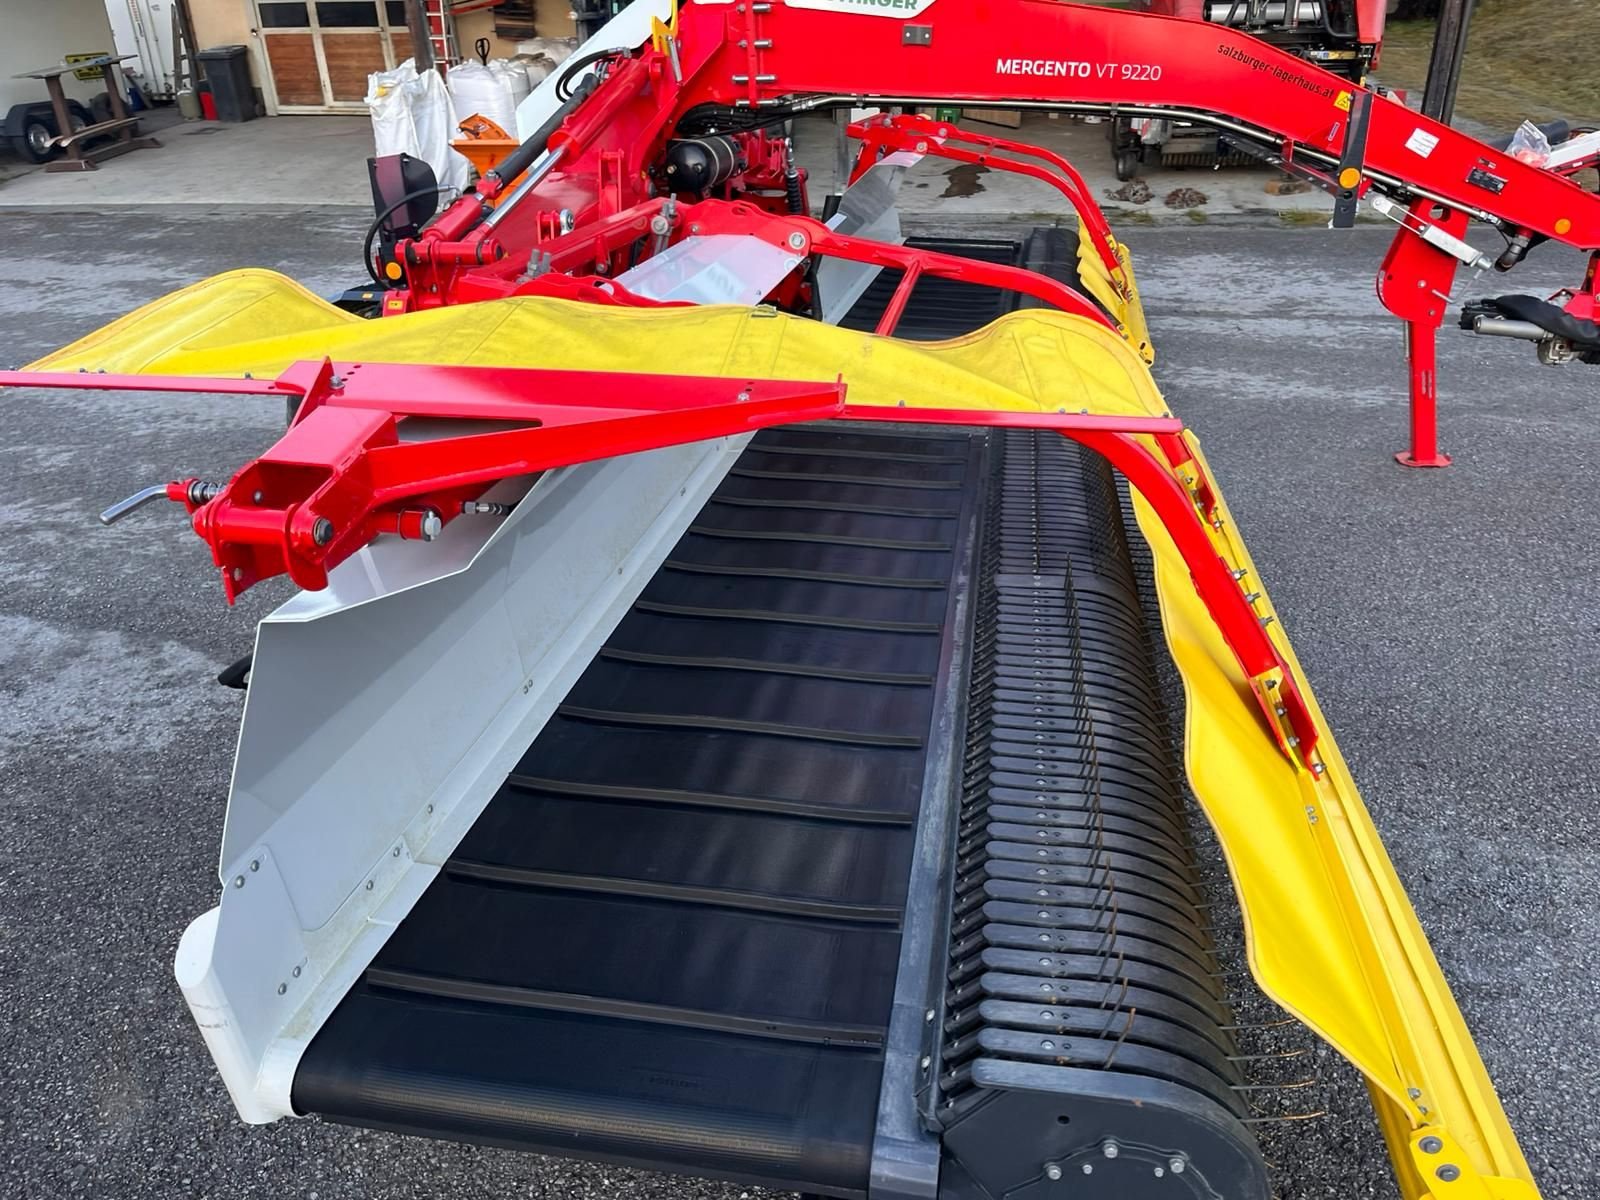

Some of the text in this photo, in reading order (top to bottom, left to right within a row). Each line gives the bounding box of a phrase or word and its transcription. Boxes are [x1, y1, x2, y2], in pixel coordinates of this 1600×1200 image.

[996, 58, 1162, 81] MERGENTO VT 9220
[1217, 44, 1335, 99] salzburger-lagerhaus.at
